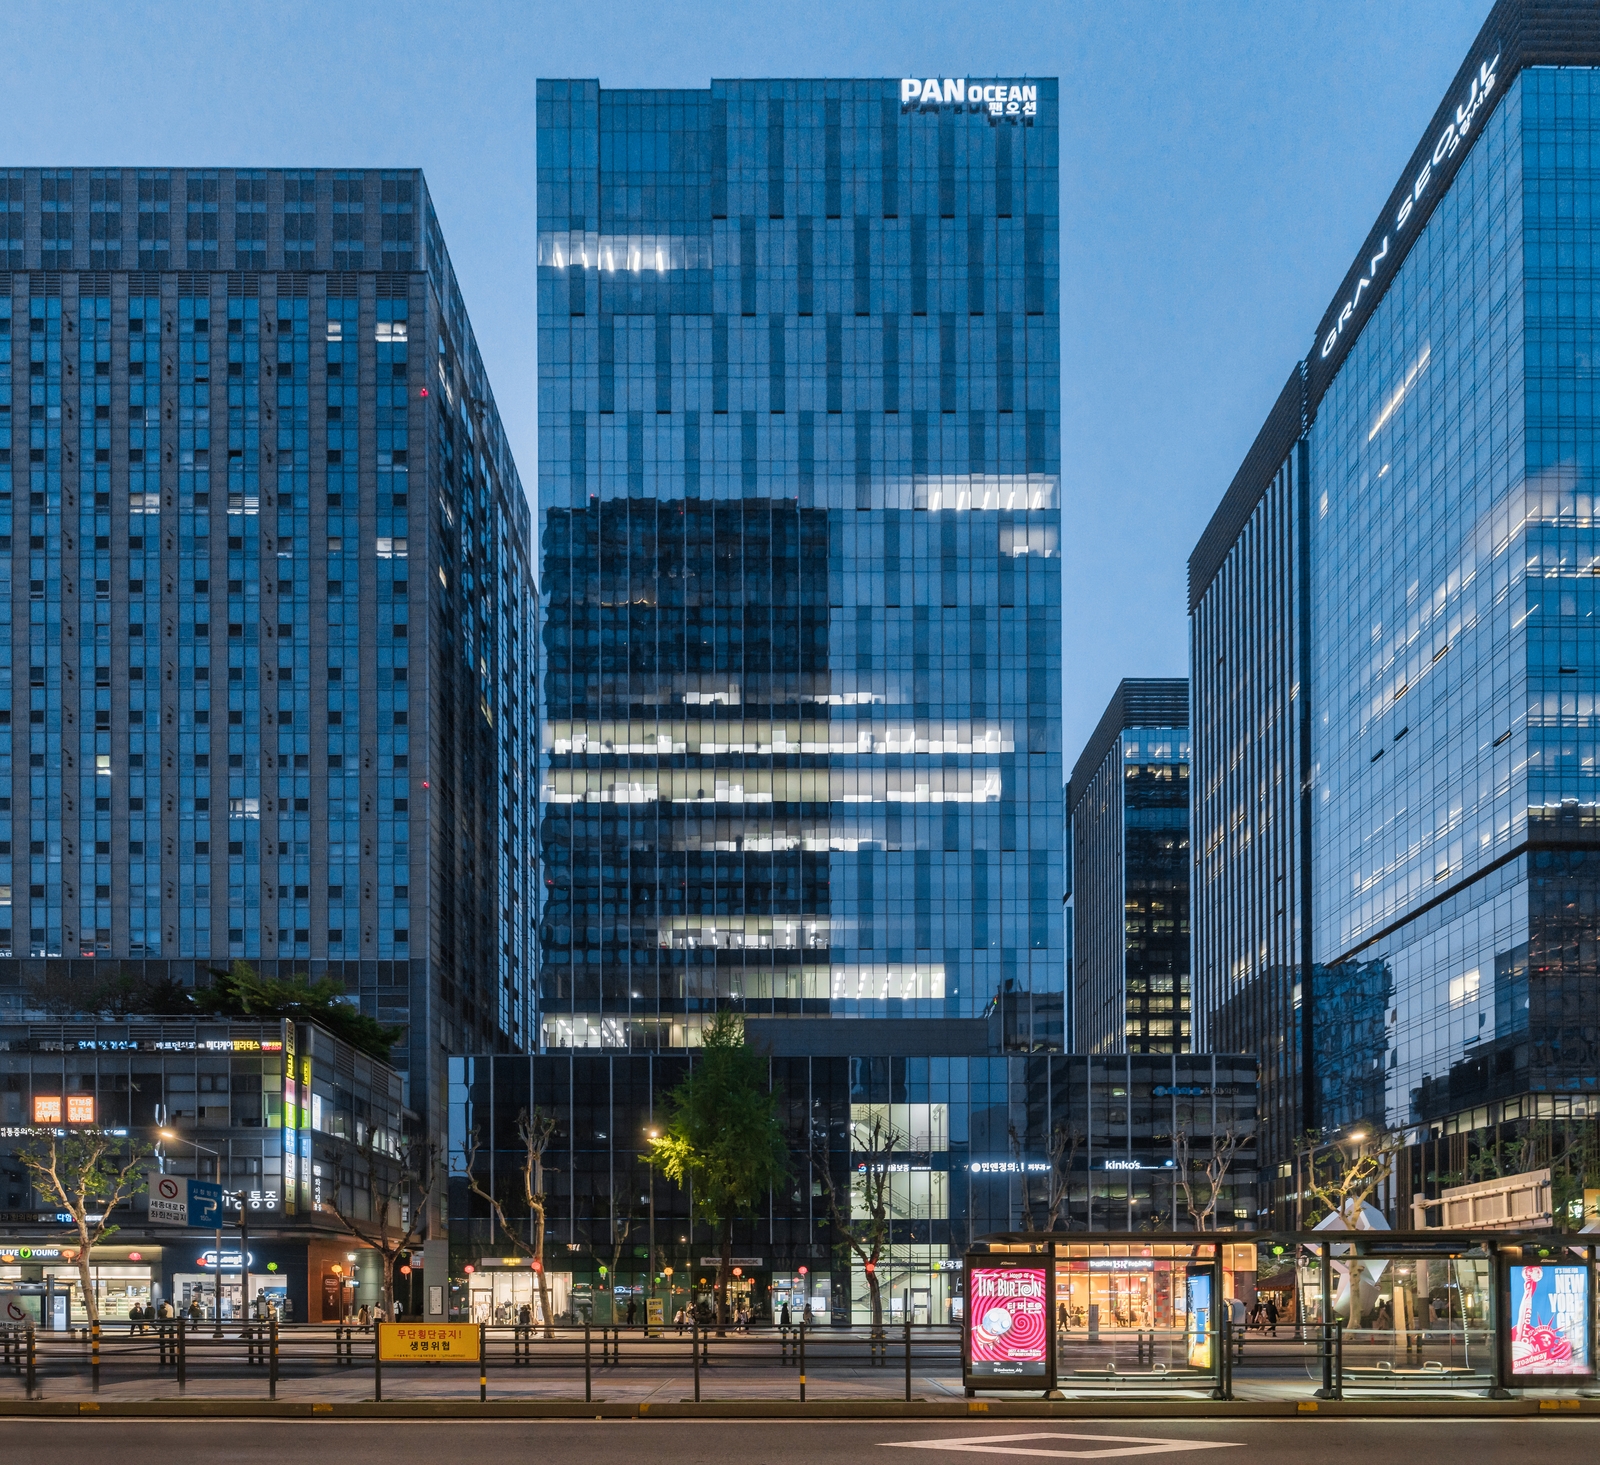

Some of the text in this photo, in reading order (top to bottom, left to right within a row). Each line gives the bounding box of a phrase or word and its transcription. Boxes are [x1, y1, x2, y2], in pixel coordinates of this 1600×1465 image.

[901, 78, 1037, 102] PAN OCEAN
[988, 101, 1037, 116] 팬오션
[1322, 54, 1500, 358] GRAN SEOUL
[1105, 1160, 1140, 1170] kinko's
[150, 1211, 187, 1222] 좌회전금지
[975, 1273, 1041, 1297] TIM BURTON
[1555, 1274, 1584, 1293] NEW
[397, 1329, 462, 1339] 무단횡단금지!
[409, 1341, 450, 1351] 생명위협
[1514, 1351, 1547, 1368] Broadway
